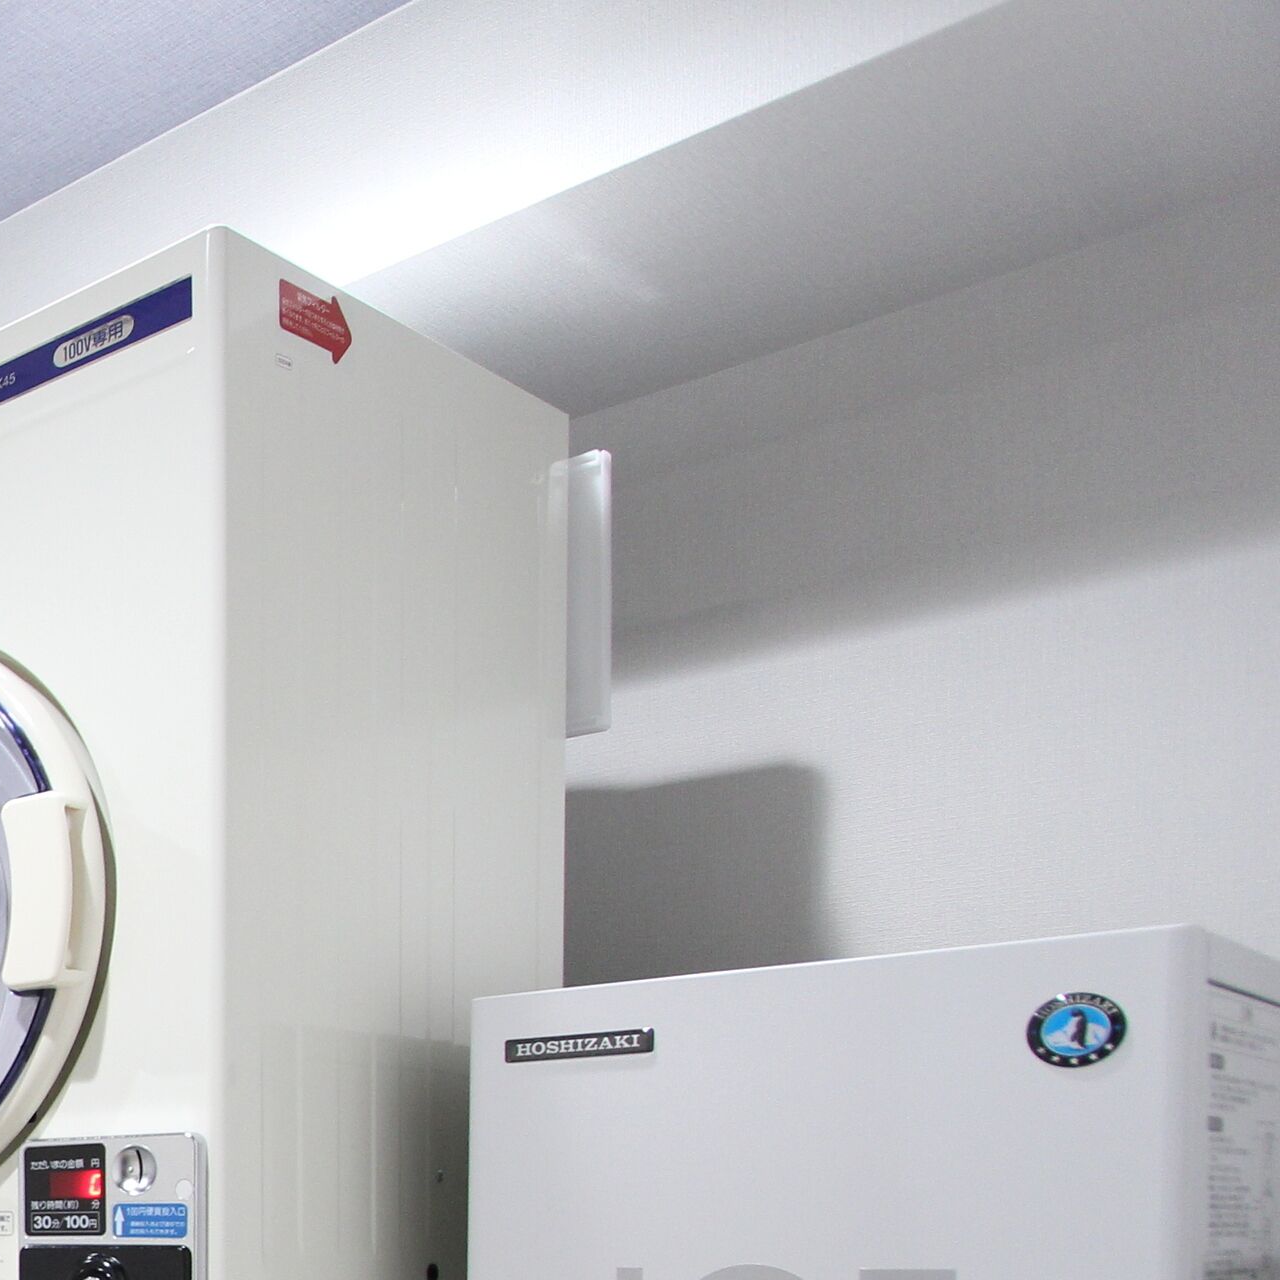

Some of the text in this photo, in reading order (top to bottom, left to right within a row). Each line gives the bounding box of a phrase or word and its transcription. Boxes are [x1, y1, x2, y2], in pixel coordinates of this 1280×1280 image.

[63, 320, 124, 362] 100V専用
[516, 1034, 640, 1057] HOSHIZAKI
[91, 1158, 100, 1168] 円
[91, 1200, 100, 1210] 分
